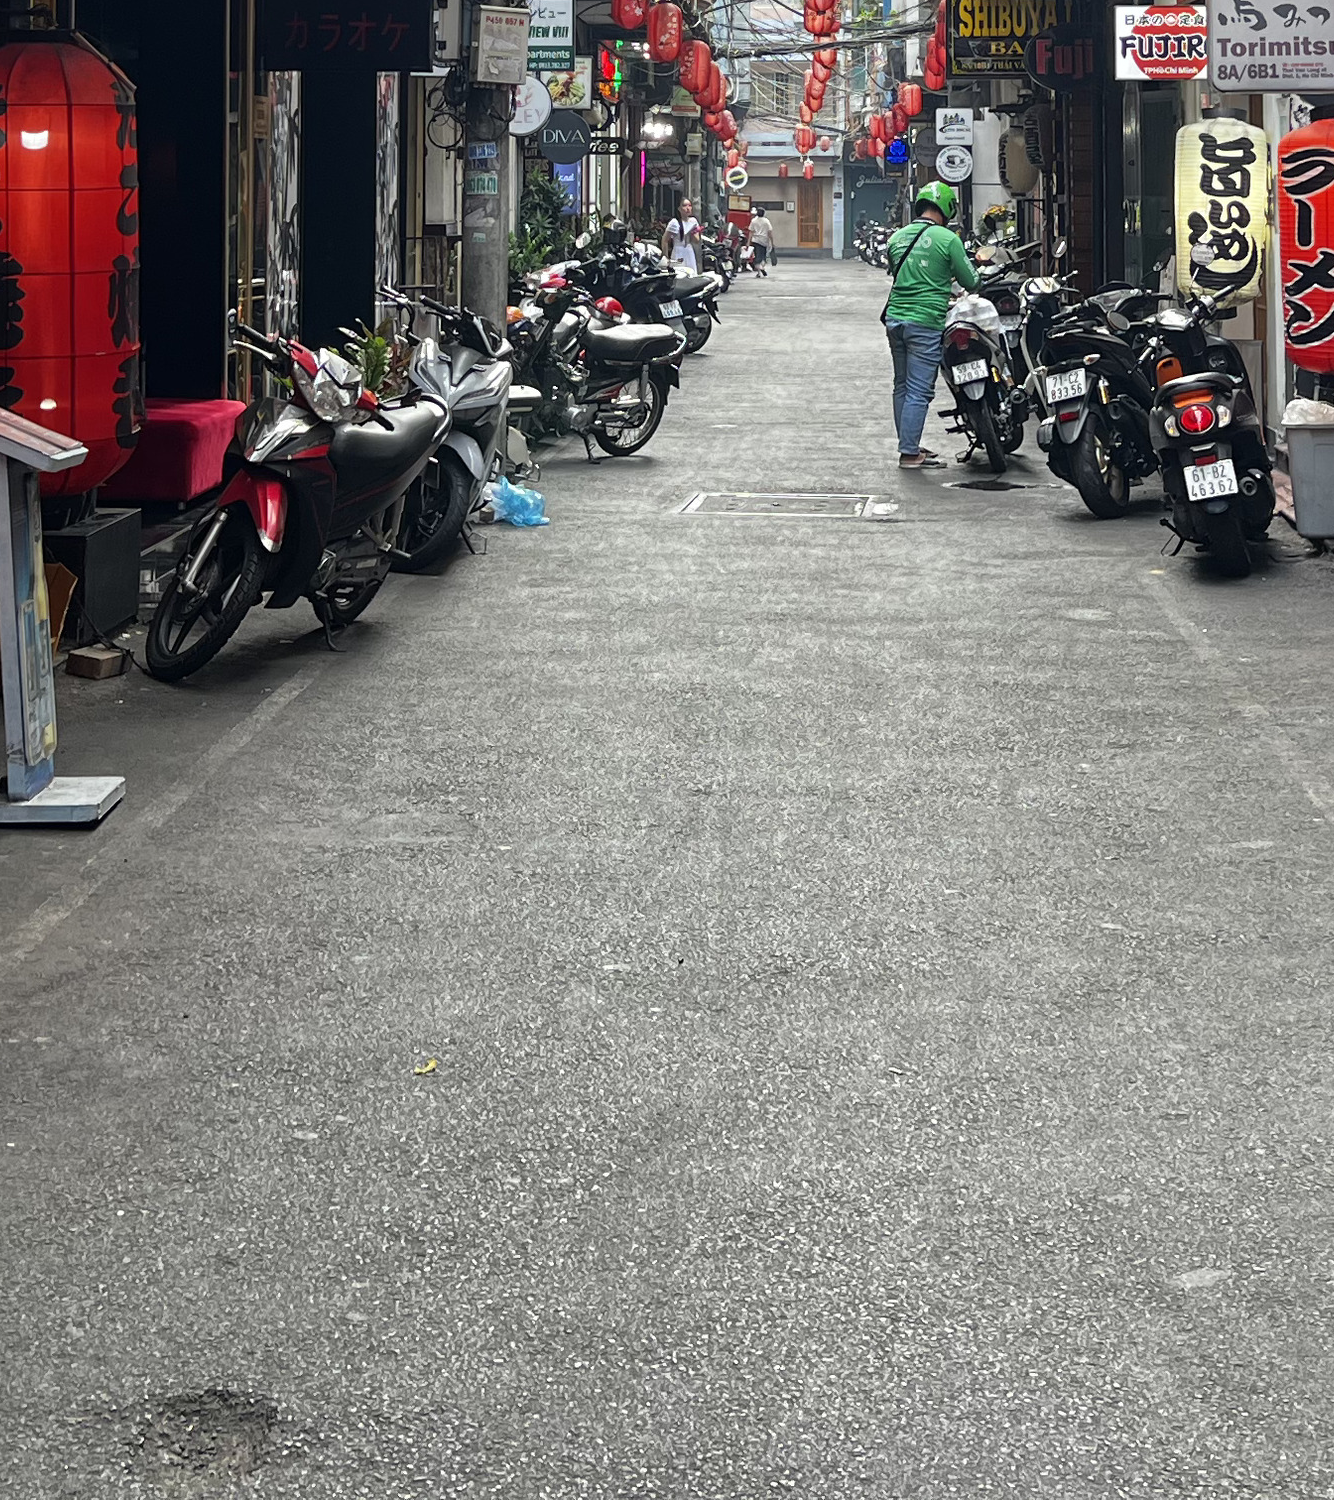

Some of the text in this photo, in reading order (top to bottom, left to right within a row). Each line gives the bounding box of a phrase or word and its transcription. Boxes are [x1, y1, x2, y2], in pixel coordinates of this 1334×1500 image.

[284, 11, 410, 51] カラオケ
[1118, 33, 1208, 59] FUJIR
[1035, 38, 1094, 80] Fuji
[1217, 62, 1280, 83] 8A/6B1
[542, 129, 586, 144] DIVA
[1191, 464, 1227, 483] 61-B2
